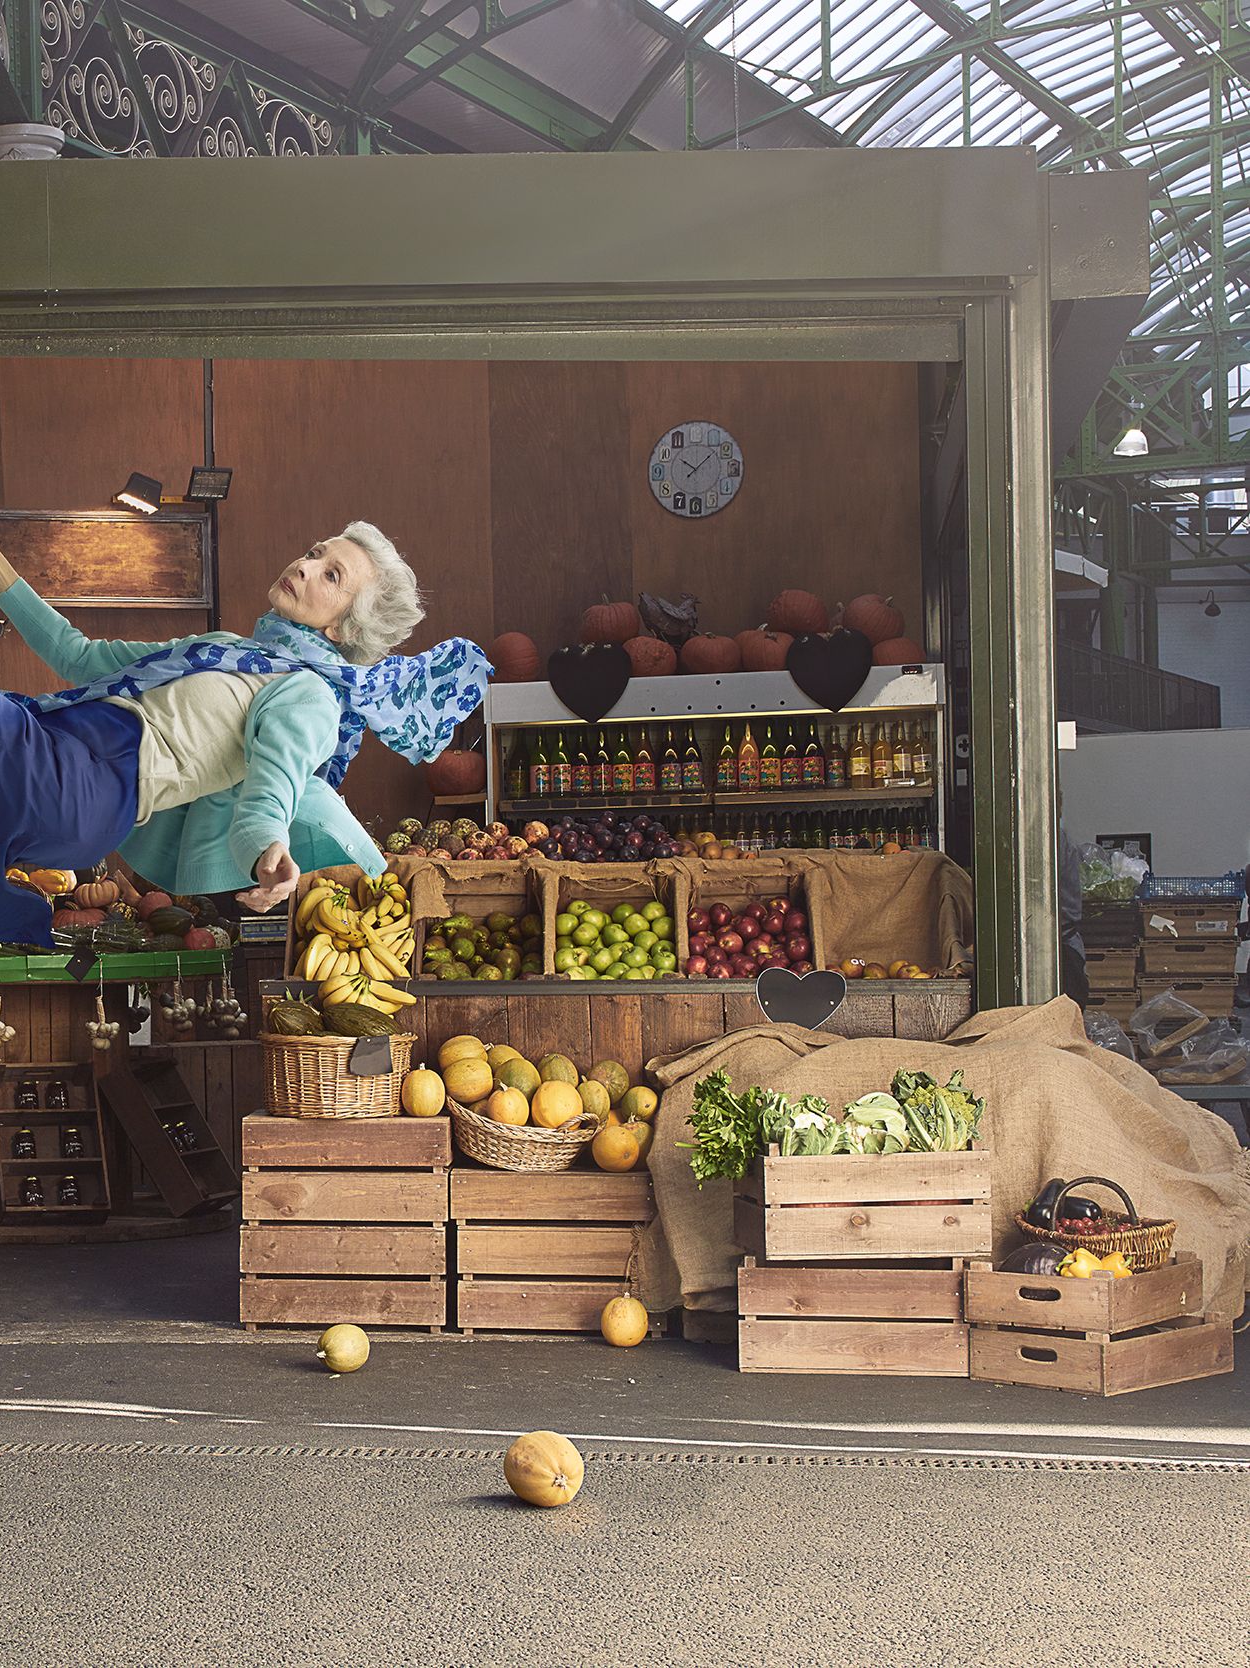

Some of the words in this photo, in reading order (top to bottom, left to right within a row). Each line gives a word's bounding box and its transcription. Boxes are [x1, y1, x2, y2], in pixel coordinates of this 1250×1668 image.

[674, 433, 682, 447] 11
[661, 447, 670, 461] 10
[722, 444, 730, 456] 2
[654, 468, 662, 479] 9
[662, 483, 670, 495] 8
[723, 480, 730, 492] 4
[675, 495, 683, 507] 7
[708, 494, 716, 506] 5
[691, 501, 699, 512] 6
